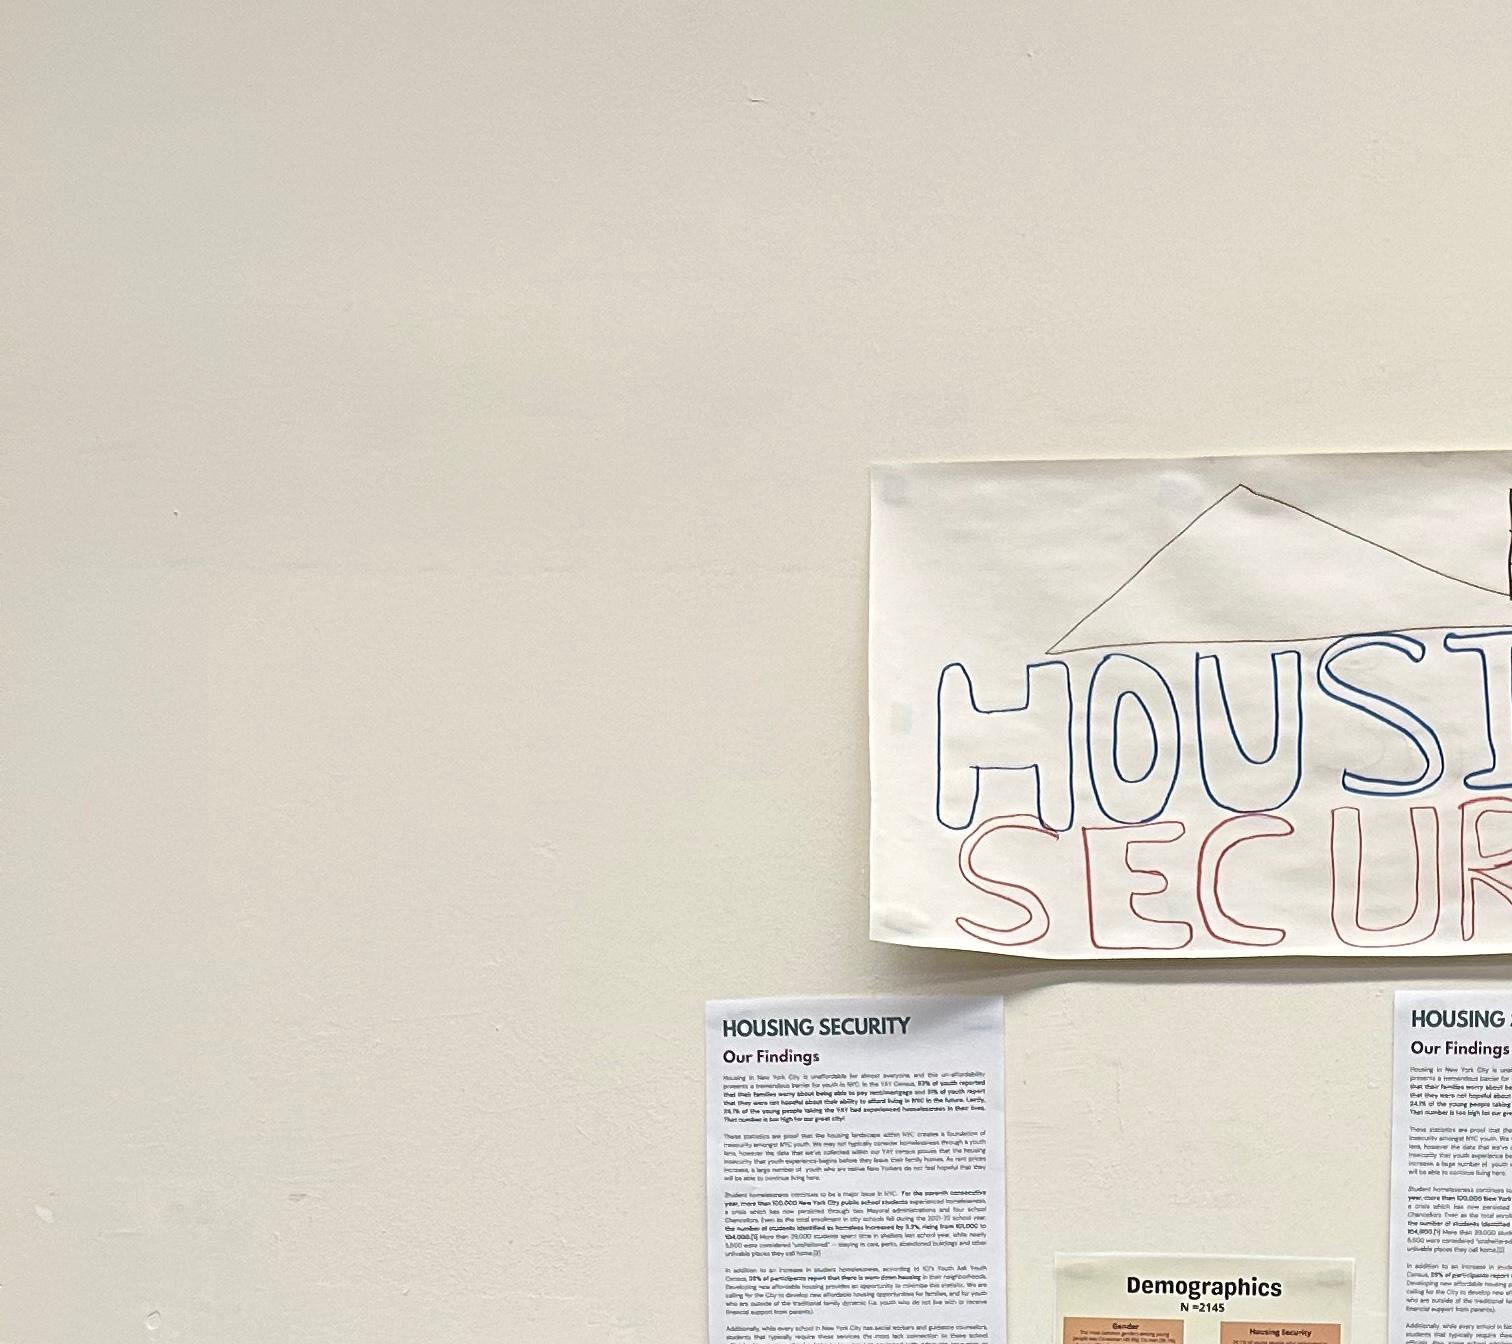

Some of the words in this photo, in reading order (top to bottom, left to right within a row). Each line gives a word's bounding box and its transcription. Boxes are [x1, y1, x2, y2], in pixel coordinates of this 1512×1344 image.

[723, 1018, 814, 1038] HOUSING
[819, 1016, 910, 1036] SECURITY
[1411, 1009, 1505, 1029] HOUSING
[723, 1049, 753, 1064] Our
[756, 1049, 820, 1065] Findings
[1410, 1041, 1442, 1055] Our
[1445, 1041, 1510, 1058] Findings
[1127, 1276, 1282, 1300] Demographics
[1180, 1303, 1189, 1312] N
